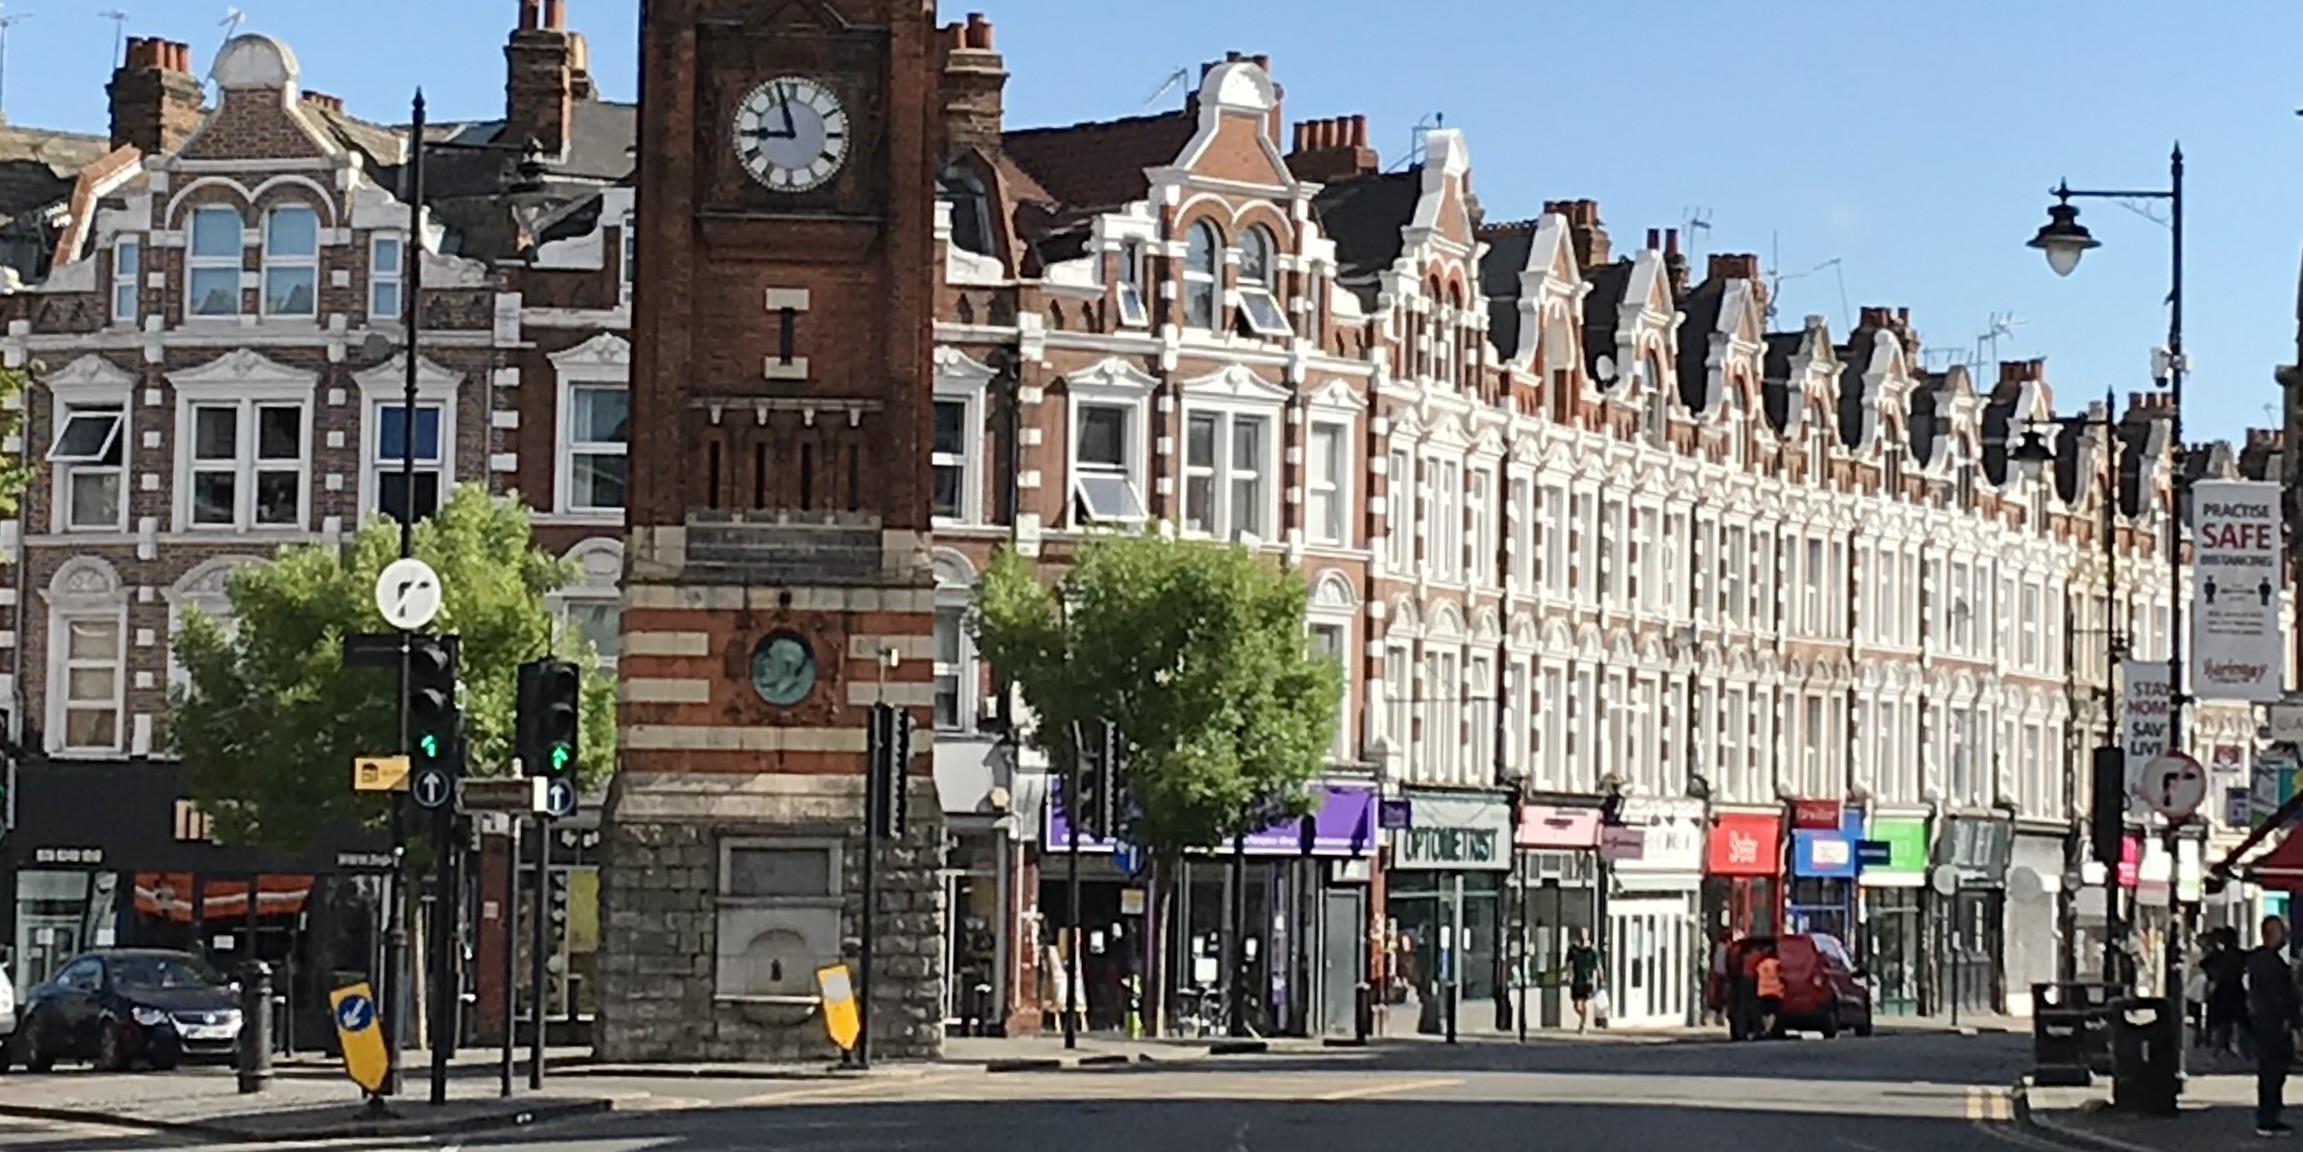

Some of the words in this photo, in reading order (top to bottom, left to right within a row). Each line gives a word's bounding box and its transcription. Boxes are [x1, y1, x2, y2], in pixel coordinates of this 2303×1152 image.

[2203, 502, 2270, 518] PRACTISE
[2202, 522, 2272, 550] SAFE
[1404, 826, 1498, 862] OPTOMETRIST
